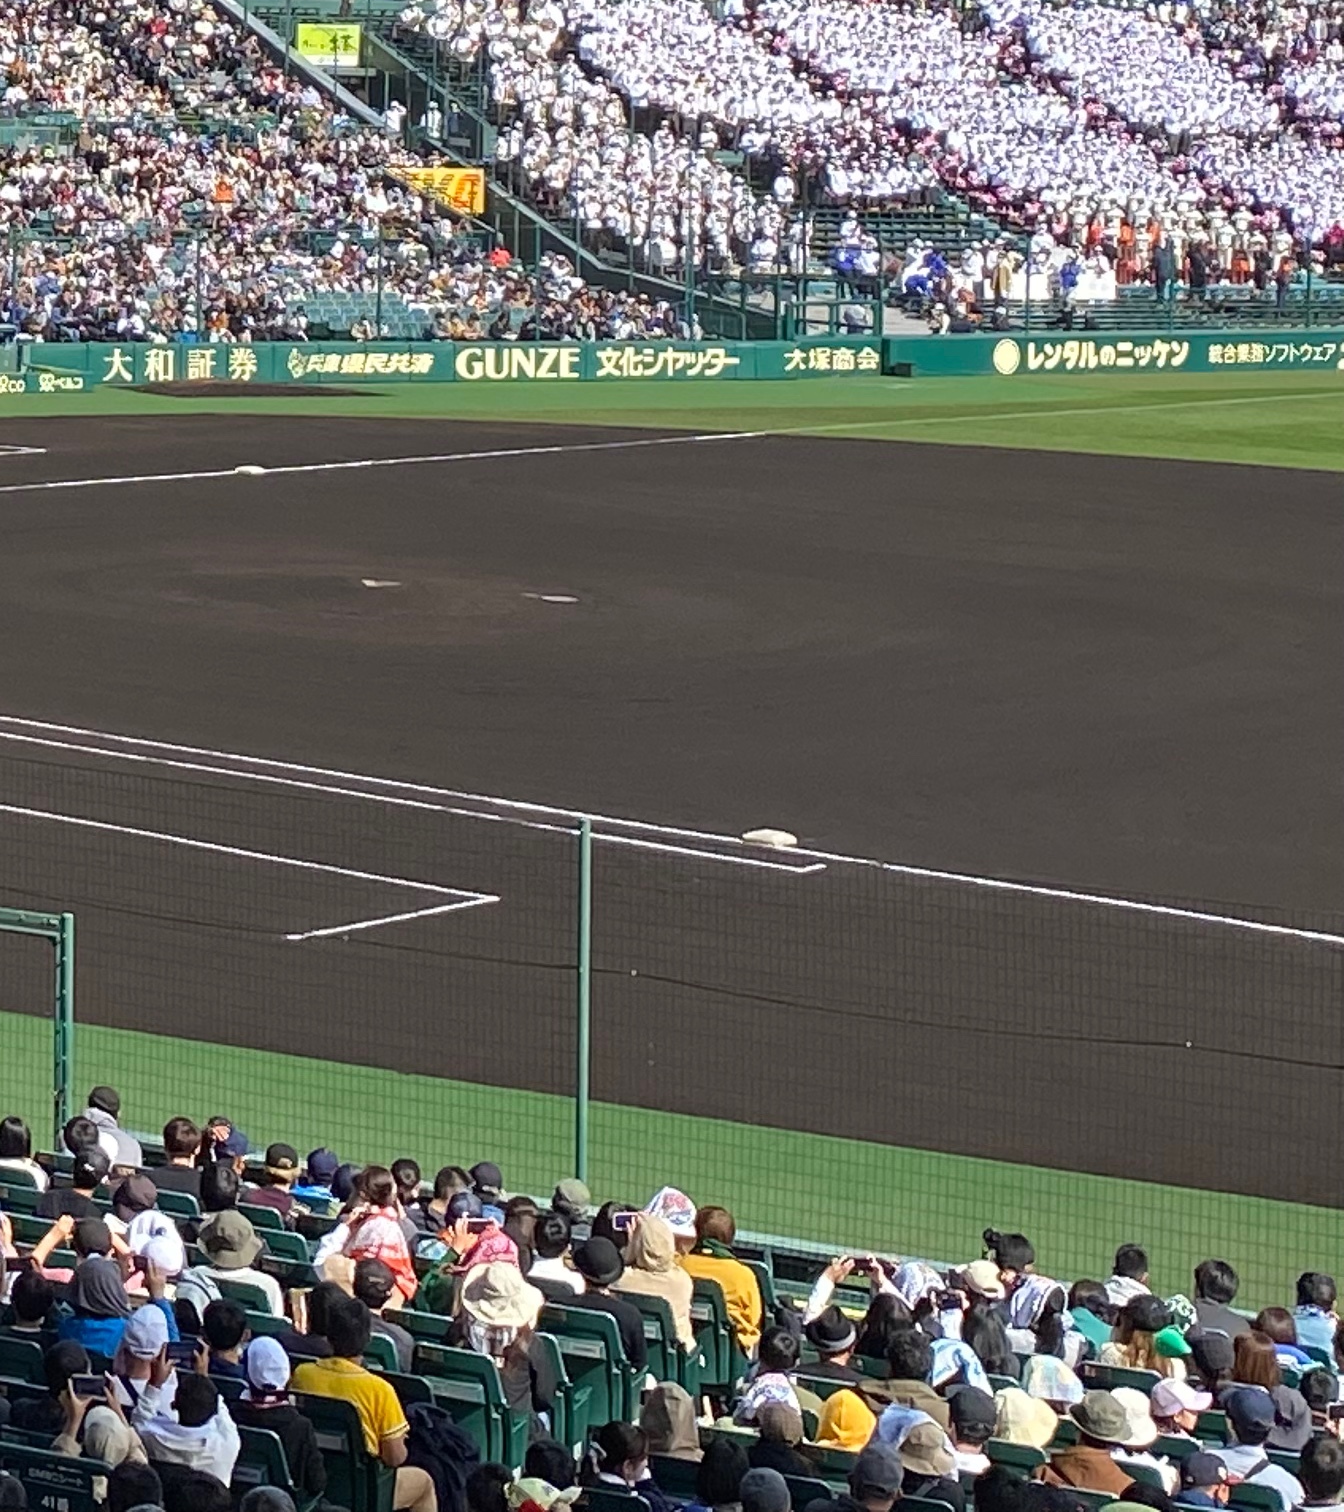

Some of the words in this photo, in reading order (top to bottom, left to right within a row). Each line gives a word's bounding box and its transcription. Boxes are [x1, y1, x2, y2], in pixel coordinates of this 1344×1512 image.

[103, 348, 258, 383] 大和証券
[455, 347, 581, 380] GUNZE
[784, 347, 880, 372] 大塚商会
[1027, 340, 1190, 371] レンタルのニッケン
